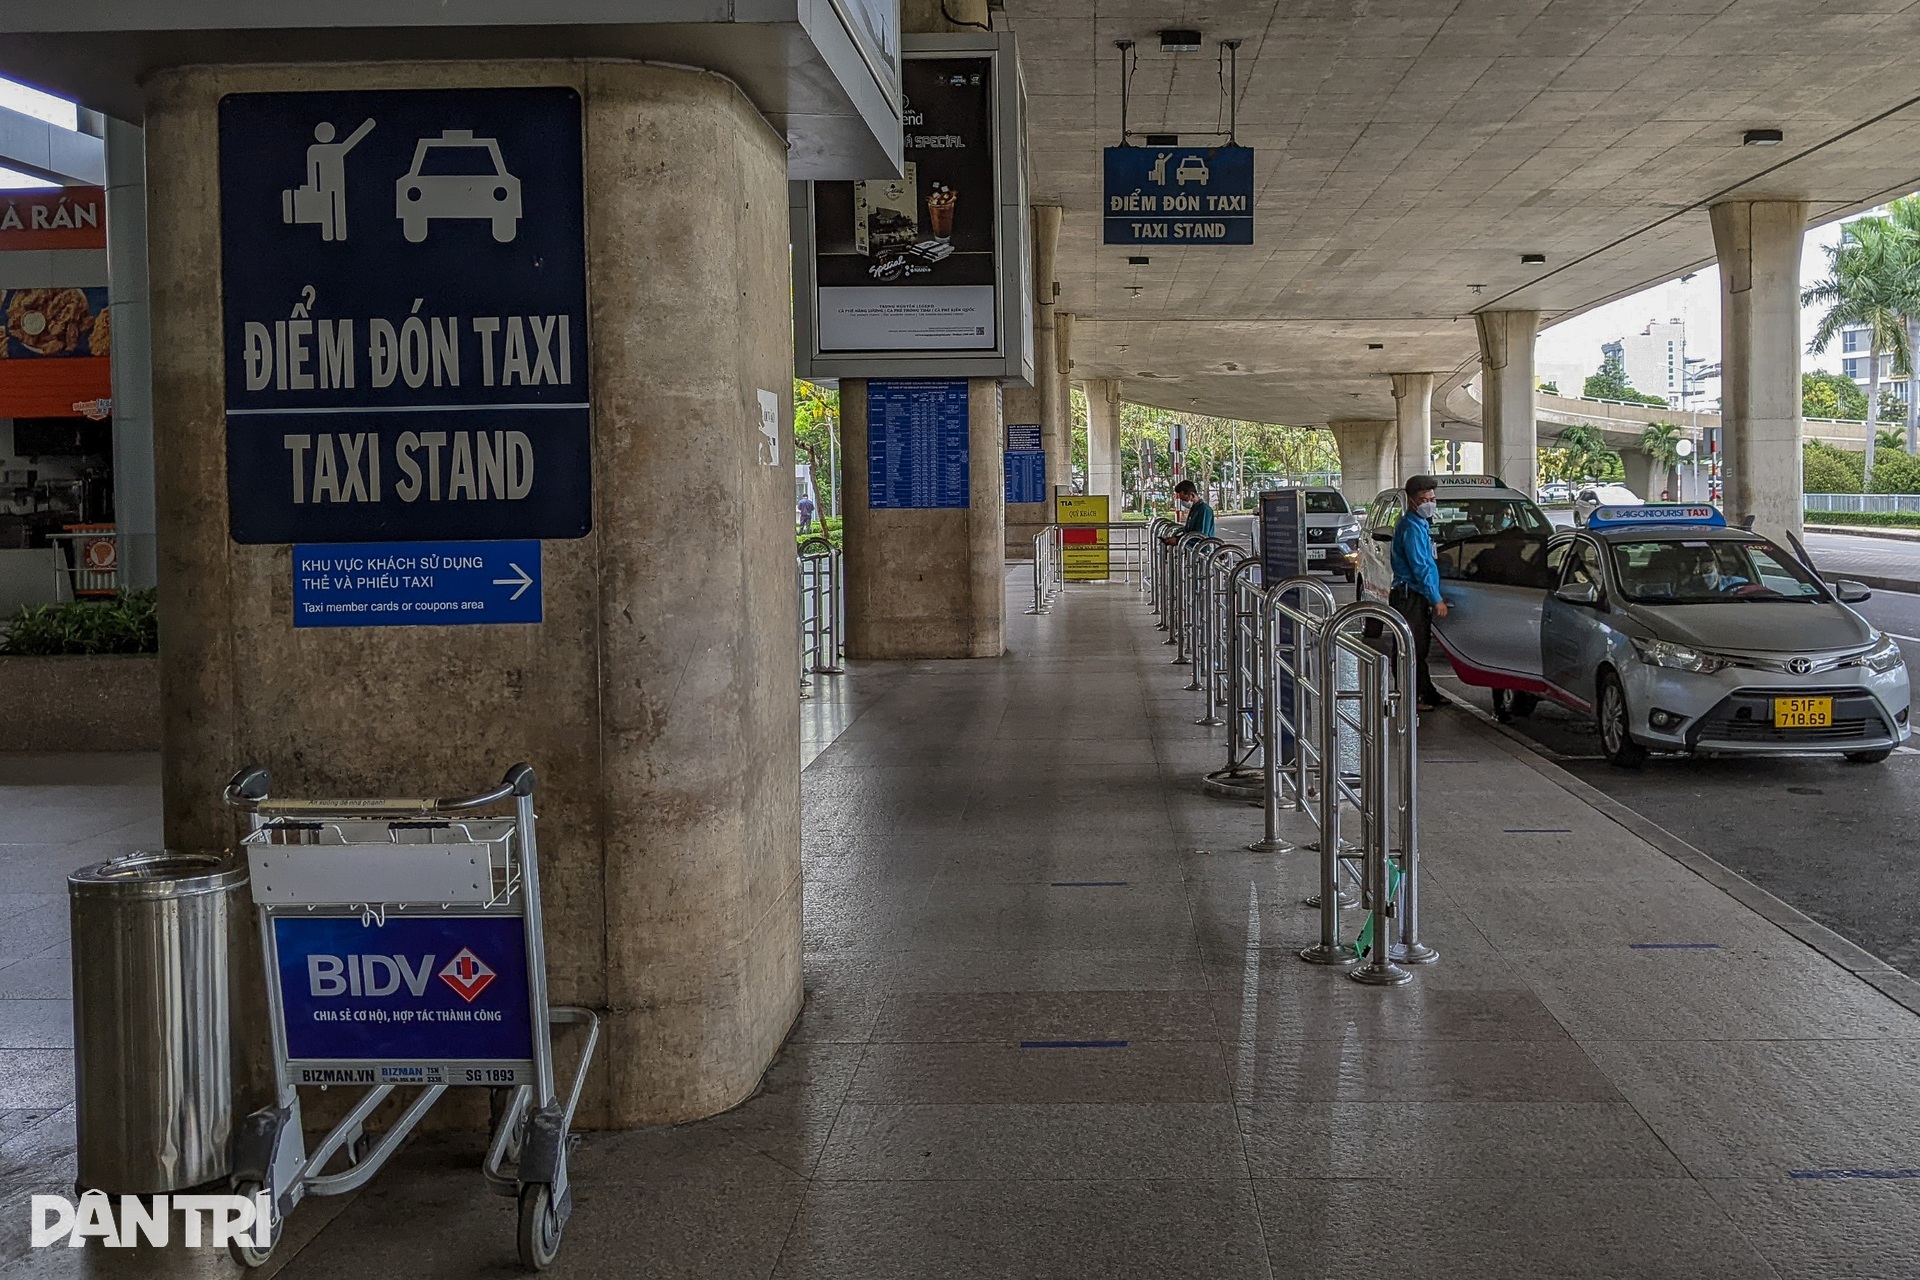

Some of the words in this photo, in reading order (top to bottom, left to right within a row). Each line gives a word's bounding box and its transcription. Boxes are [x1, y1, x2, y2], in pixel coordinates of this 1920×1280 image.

[1110, 188, 1157, 211] ĐIỂM
[1163, 191, 1200, 211] ĐÓN
[1206, 195, 1247, 211] TAXI
[31, 197, 97, 229] RÁN
[1131, 223, 1168, 238] TAXI
[1173, 223, 1226, 238] STAND
[243, 284, 355, 391] ĐIỂM
[368, 298, 460, 389] ĐÓN
[472, 315, 571, 387] TAXI
[284, 432, 381, 504] TAXI
[395, 430, 534, 503] STAND
[1616, 509, 1685, 518] SAIGONTOURIST
[1686, 508, 1708, 517] TAXI
[302, 559, 331, 571] KHU
[334, 558, 363, 573] VỰC
[367, 556, 416, 571] KHÁCH
[420, 554, 439, 569] SỬ
[443, 556, 483, 571] DỤNG
[302, 574, 330, 590] THẺ
[334, 575, 353, 590] VÀ
[357, 573, 399, 589] PHIẾU
[402, 576, 434, 588] TAXI
[303, 602, 323, 612] Taxi
[326, 602, 367, 612] member
[370, 601, 399, 611] cards
[401, 602, 411, 611] or
[415, 602, 458, 613] coupons
[461, 601, 484, 610] area
[1791, 699, 1816, 712] 51F
[1781, 713, 1826, 725] 718.69
[307, 954, 436, 997] BIDV
[313, 1010, 338, 1021] CHIA
[339, 1008, 351, 1021] SẺ
[353, 1010, 367, 1021] CƠ
[369, 1009, 391, 1023] HỘI,
[393, 1010, 414, 1023] HỢP
[415, 1009, 434, 1021] TÁC
[436, 1009, 472, 1021] THÀNH
[474, 1009, 501, 1021] CÔNG
[302, 1069, 375, 1082] BIZMAN.VN
[381, 1067, 423, 1076] BIZMAN
[465, 1069, 482, 1082] SG
[485, 1069, 515, 1082] 1893
